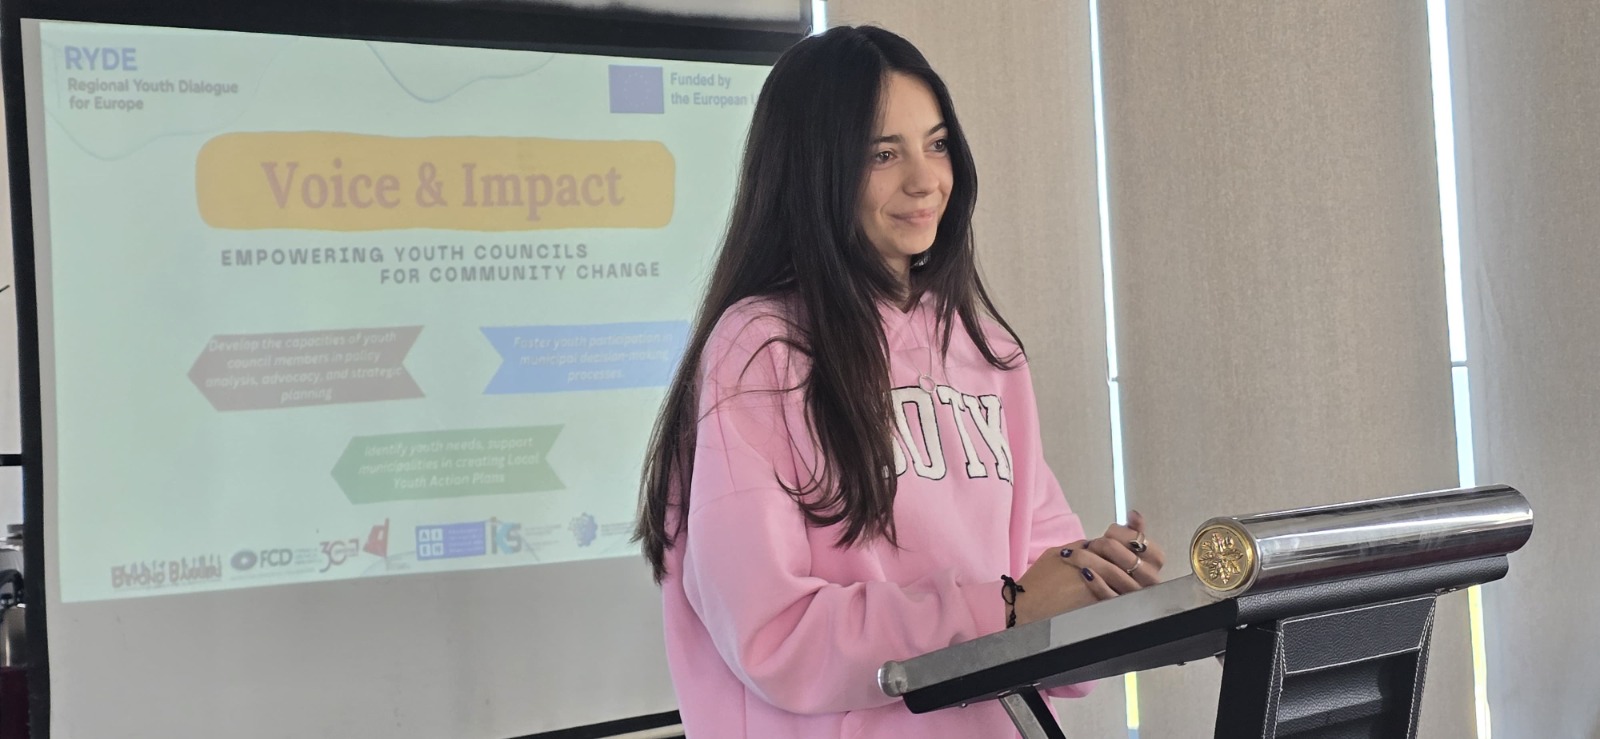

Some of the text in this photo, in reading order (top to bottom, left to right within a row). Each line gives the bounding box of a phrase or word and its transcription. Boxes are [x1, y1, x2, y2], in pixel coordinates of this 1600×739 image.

[64, 45, 138, 71] RYDE
[67, 77, 239, 96] Regional Youth Dialogue
[670, 72, 732, 90] Funded by
[69, 95, 144, 112] for Europe
[671, 92, 690, 106] the
[693, 93, 748, 109] European
[260, 157, 625, 222] Voice & Impact
[221, 243, 589, 267] EMPOWERING YOUTH COUNCILS
[380, 261, 661, 285] FOR COMMUNITY CHANGE
[208, 330, 398, 353] Develop the capacities of youth
[553, 335, 587, 351] youth
[588, 331, 662, 348] participation
[227, 349, 382, 370] council members in policy
[520, 352, 577, 367] municipal
[326, 367, 349, 382] and
[280, 386, 334, 405] planning
[364, 441, 407, 458] Identify
[410, 439, 444, 455] youth
[487, 436, 534, 451] support
[358, 451, 541, 475] municipalities in creating Local
[393, 469, 505, 490] Youth Action Plans
[259, 548, 294, 569] FCD
